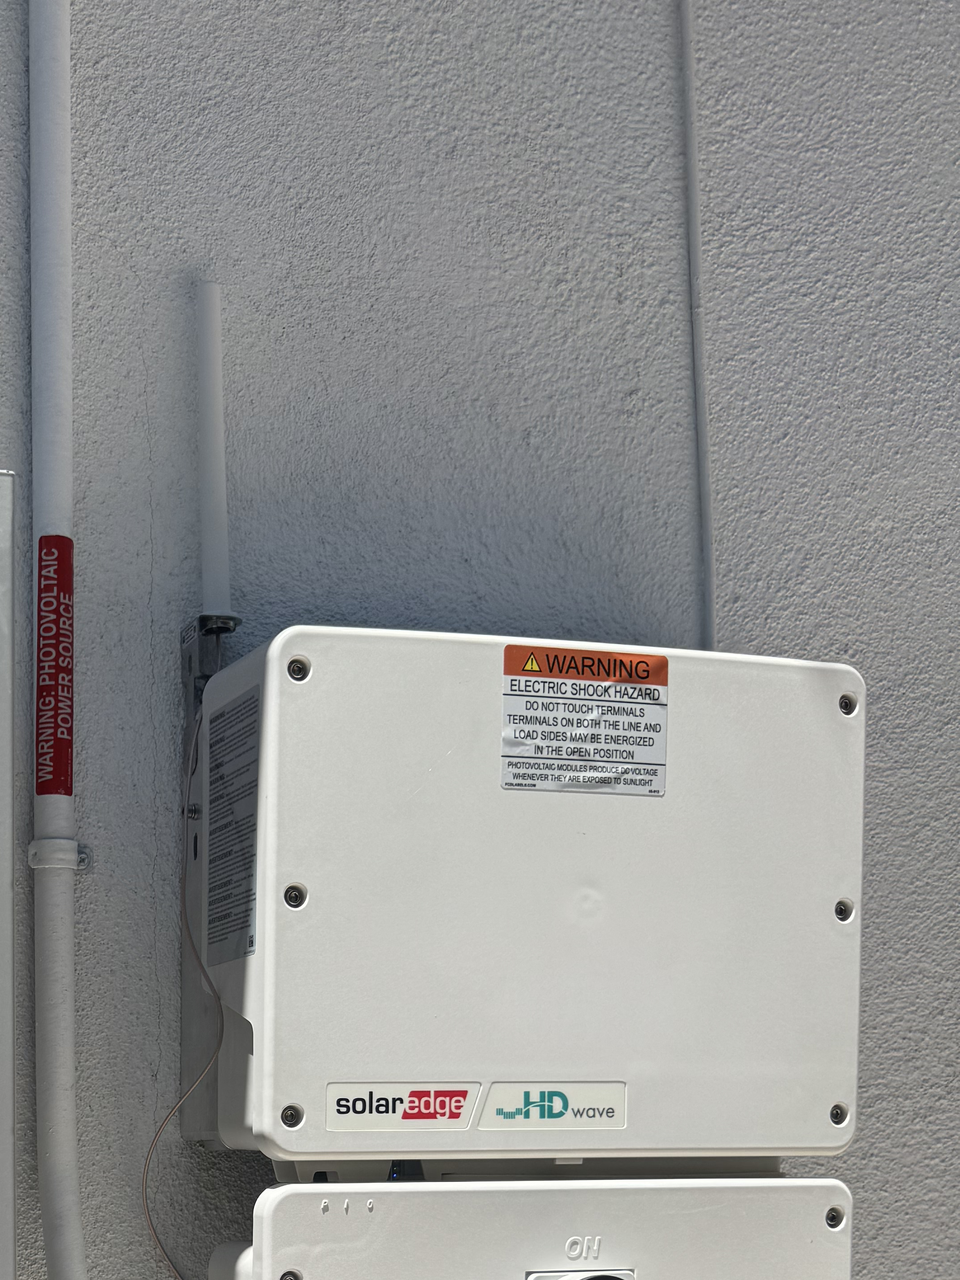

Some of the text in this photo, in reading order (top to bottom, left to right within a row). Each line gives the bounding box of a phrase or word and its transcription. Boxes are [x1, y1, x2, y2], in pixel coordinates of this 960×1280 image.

[39, 548, 58, 782] WARNING: PHOTOVOLTAIC
[58, 592, 72, 740] POWER SOURCE
[546, 654, 650, 679] WARNING
[510, 679, 660, 700] ELECTRIC SHOCK HAZARD
[525, 701, 645, 717] DO NOT TOUCH TERMINALS
[336, 1091, 465, 1119] solaredge
[524, 1091, 615, 1119] HD wave
[565, 1236, 601, 1260] ON
